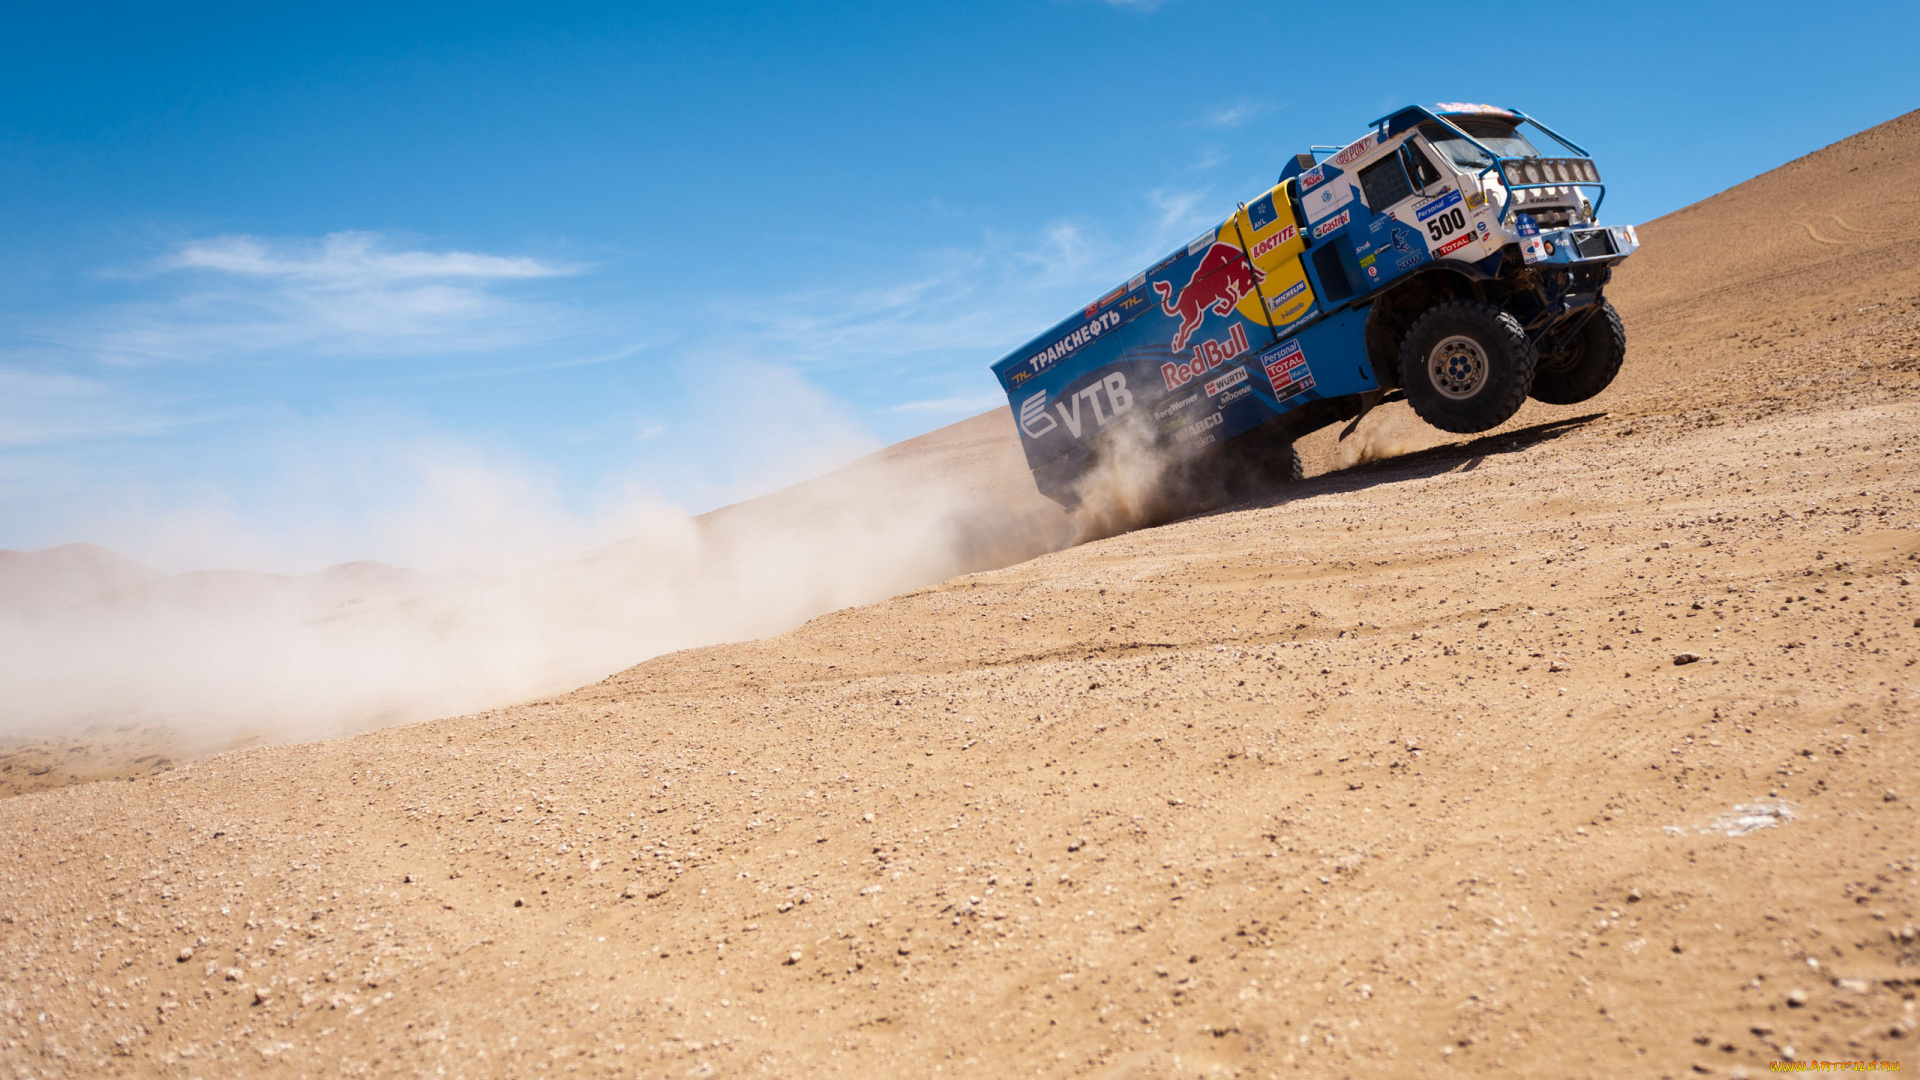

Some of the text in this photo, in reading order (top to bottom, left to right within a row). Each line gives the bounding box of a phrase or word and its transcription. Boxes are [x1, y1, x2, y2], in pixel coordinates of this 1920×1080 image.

[1417, 199, 1445, 219] Personal
[1254, 218, 1268, 229] AVL
[1322, 211, 1349, 234] Castrol
[1427, 207, 1466, 241] 500
[1253, 224, 1295, 258] LOCTITE
[1274, 281, 1304, 304] MICHELIN
[1030, 310, 1120, 372] ТРАНСНЕФТЬ
[1162, 321, 1249, 391] Red Bull
[1263, 341, 1297, 365] Personal
[1267, 356, 1303, 375] TOTAL
[1291, 366, 1309, 379] Macro
[1215, 368, 1246, 389] WÜRTH
[1055, 371, 1134, 439] VTB
[1221, 384, 1252, 405] MODINE
[1154, 393, 1199, 420] BorgWarner
[1175, 411, 1224, 443] WABCO
